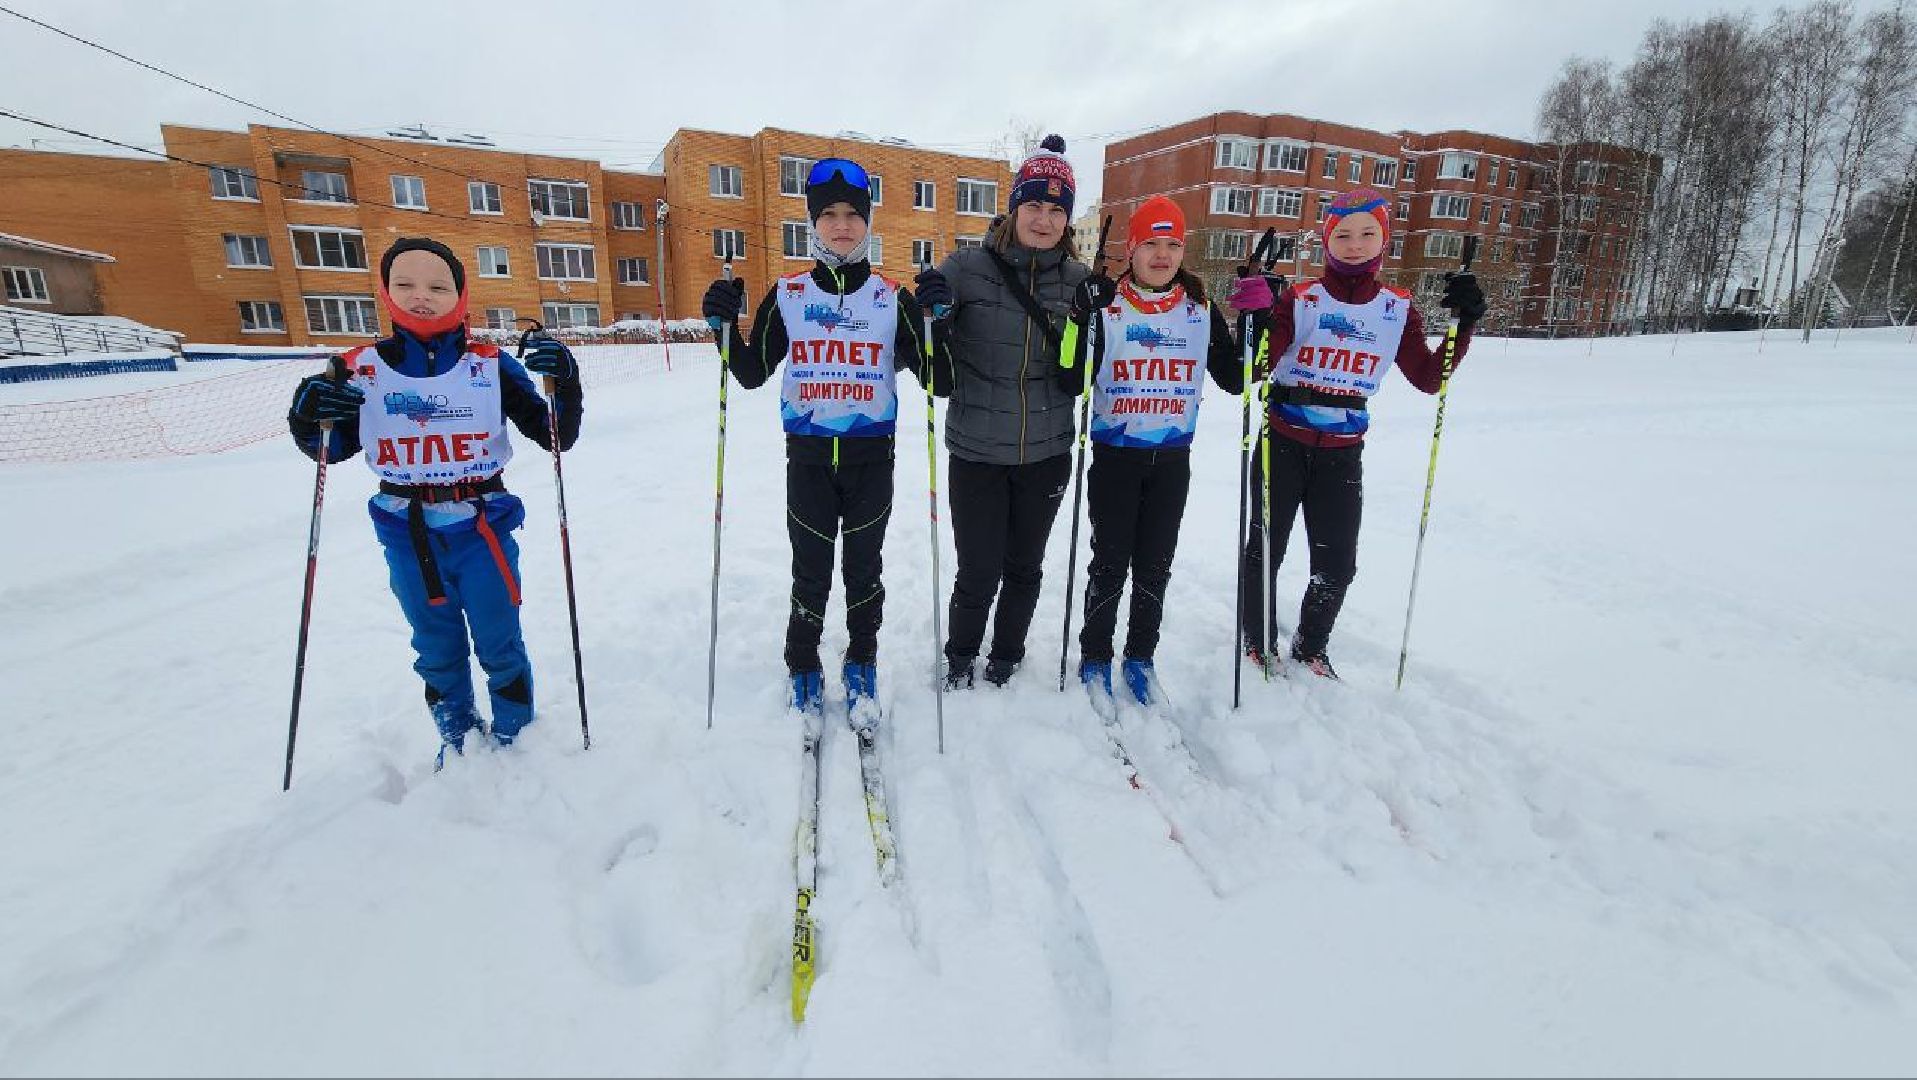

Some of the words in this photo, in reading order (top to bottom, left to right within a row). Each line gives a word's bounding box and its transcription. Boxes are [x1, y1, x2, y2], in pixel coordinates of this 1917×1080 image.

[791, 340, 884, 366] АТЛЕТ
[1296, 346, 1381, 377] АТЛЕТ
[1112, 359, 1199, 382] АТЛЕТ
[799, 381, 874, 402] ДМИТРОВ
[376, 432, 490, 467] АТЛЕТ
